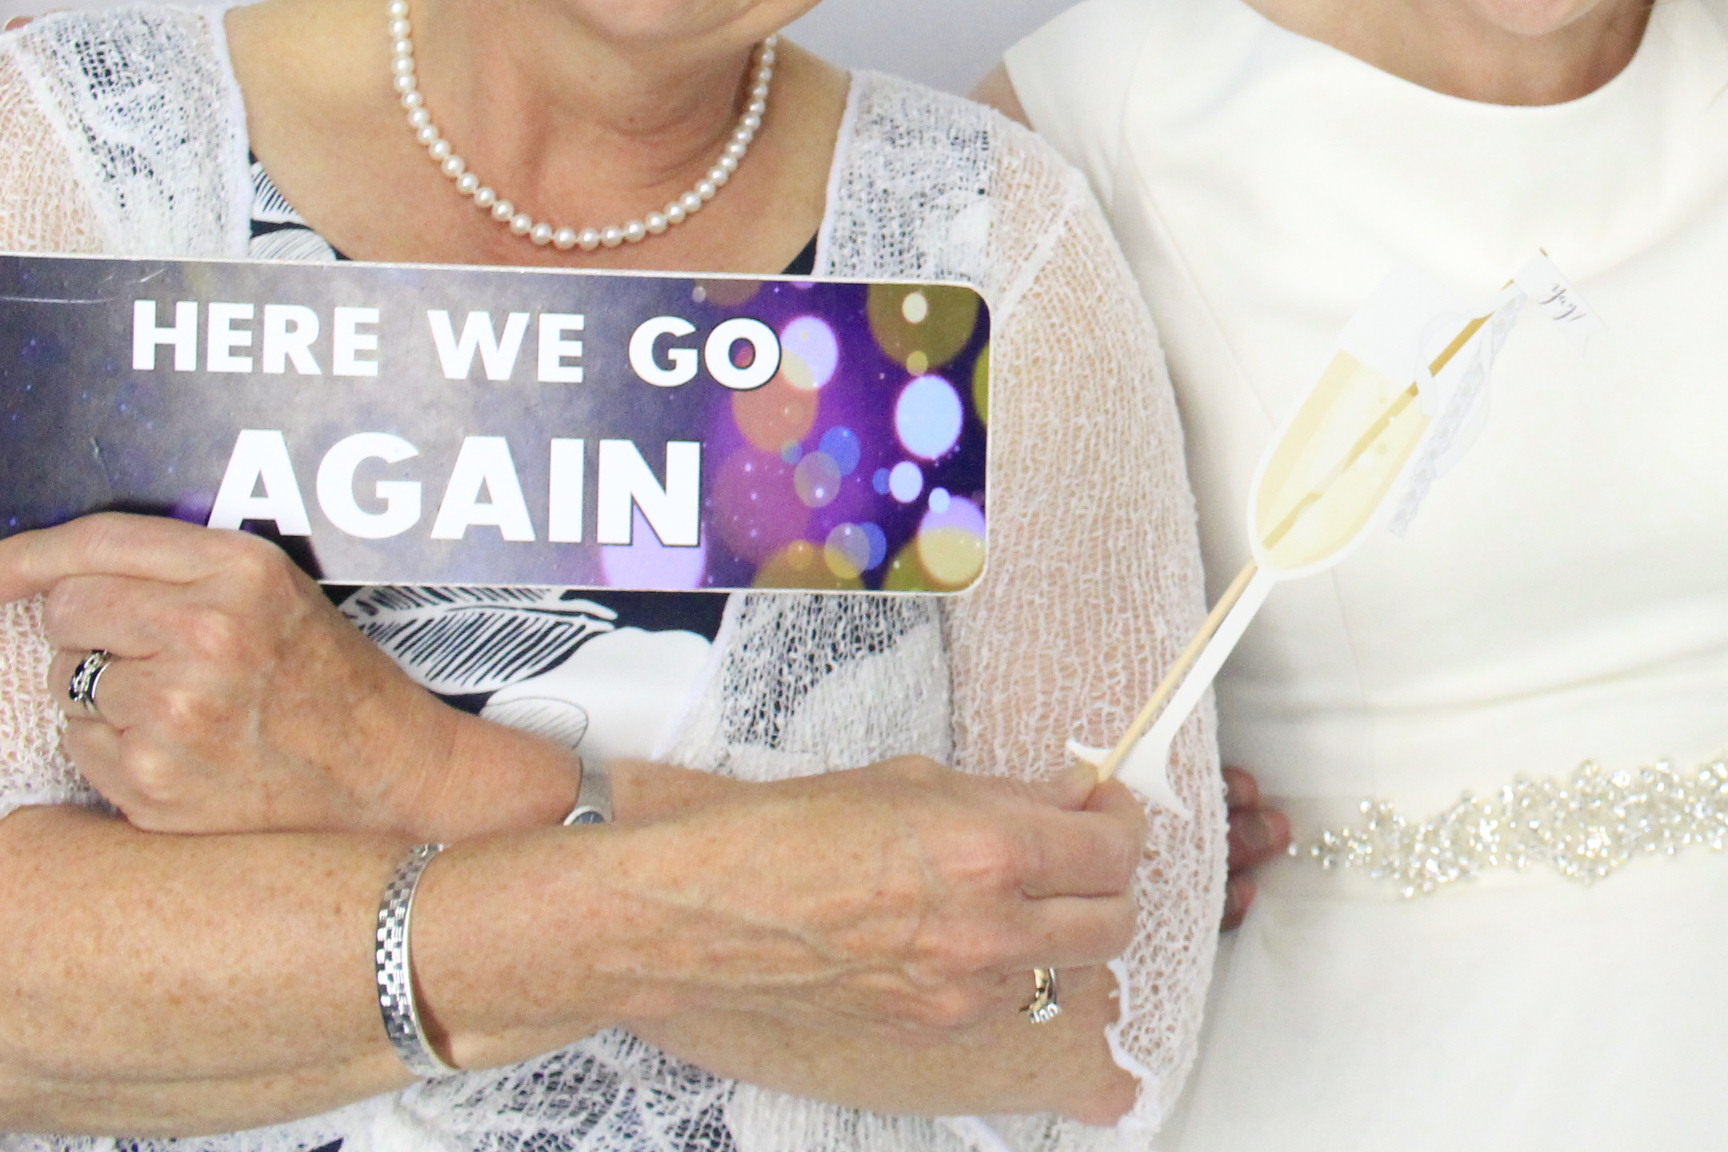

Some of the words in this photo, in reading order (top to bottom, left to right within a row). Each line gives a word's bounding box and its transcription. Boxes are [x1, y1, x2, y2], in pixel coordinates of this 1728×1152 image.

[131, 299, 380, 378] HERE
[427, 309, 584, 383] WE
[628, 316, 781, 390] GO
[206, 428, 702, 547] AGAIN
